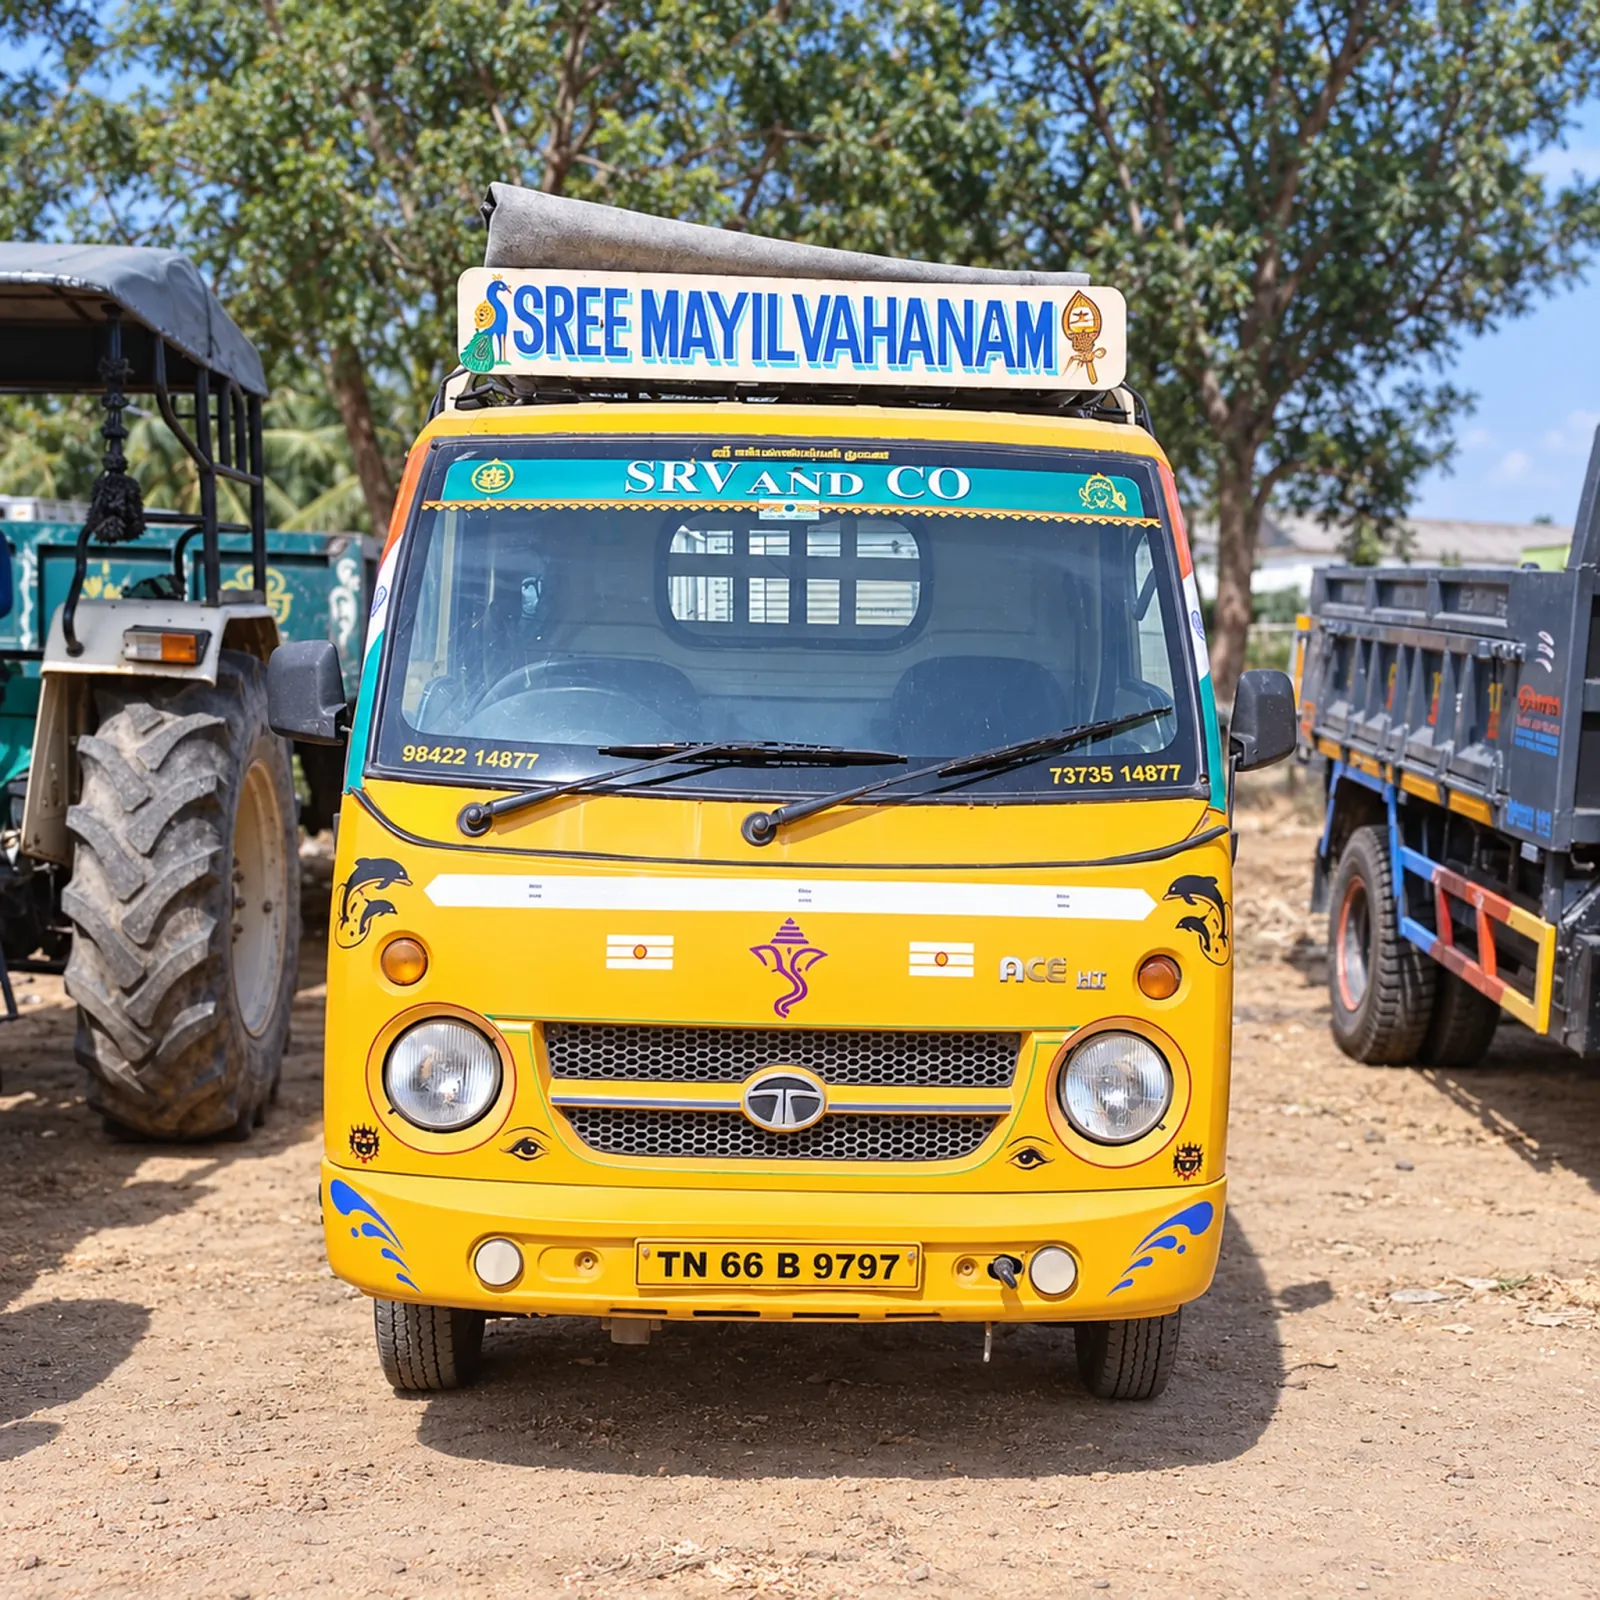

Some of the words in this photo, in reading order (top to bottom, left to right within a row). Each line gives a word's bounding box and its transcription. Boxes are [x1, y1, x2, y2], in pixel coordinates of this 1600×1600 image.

[513, 284, 632, 363] SREE
[641, 288, 1058, 375] MAYILVAHANAM
[624, 460, 741, 494] SRV
[745, 470, 865, 496] AND
[886, 465, 972, 500] CO
[402, 744, 468, 765] 98422
[474, 749, 540, 770] 14877
[1050, 765, 1114, 785] 73735
[1120, 763, 1182, 782] 14877
[999, 955, 1067, 983] ACE
[657, 1250, 707, 1278] TN
[720, 1251, 764, 1279] 66
[777, 1252, 801, 1279] B
[812, 1253, 900, 1280] 9797
